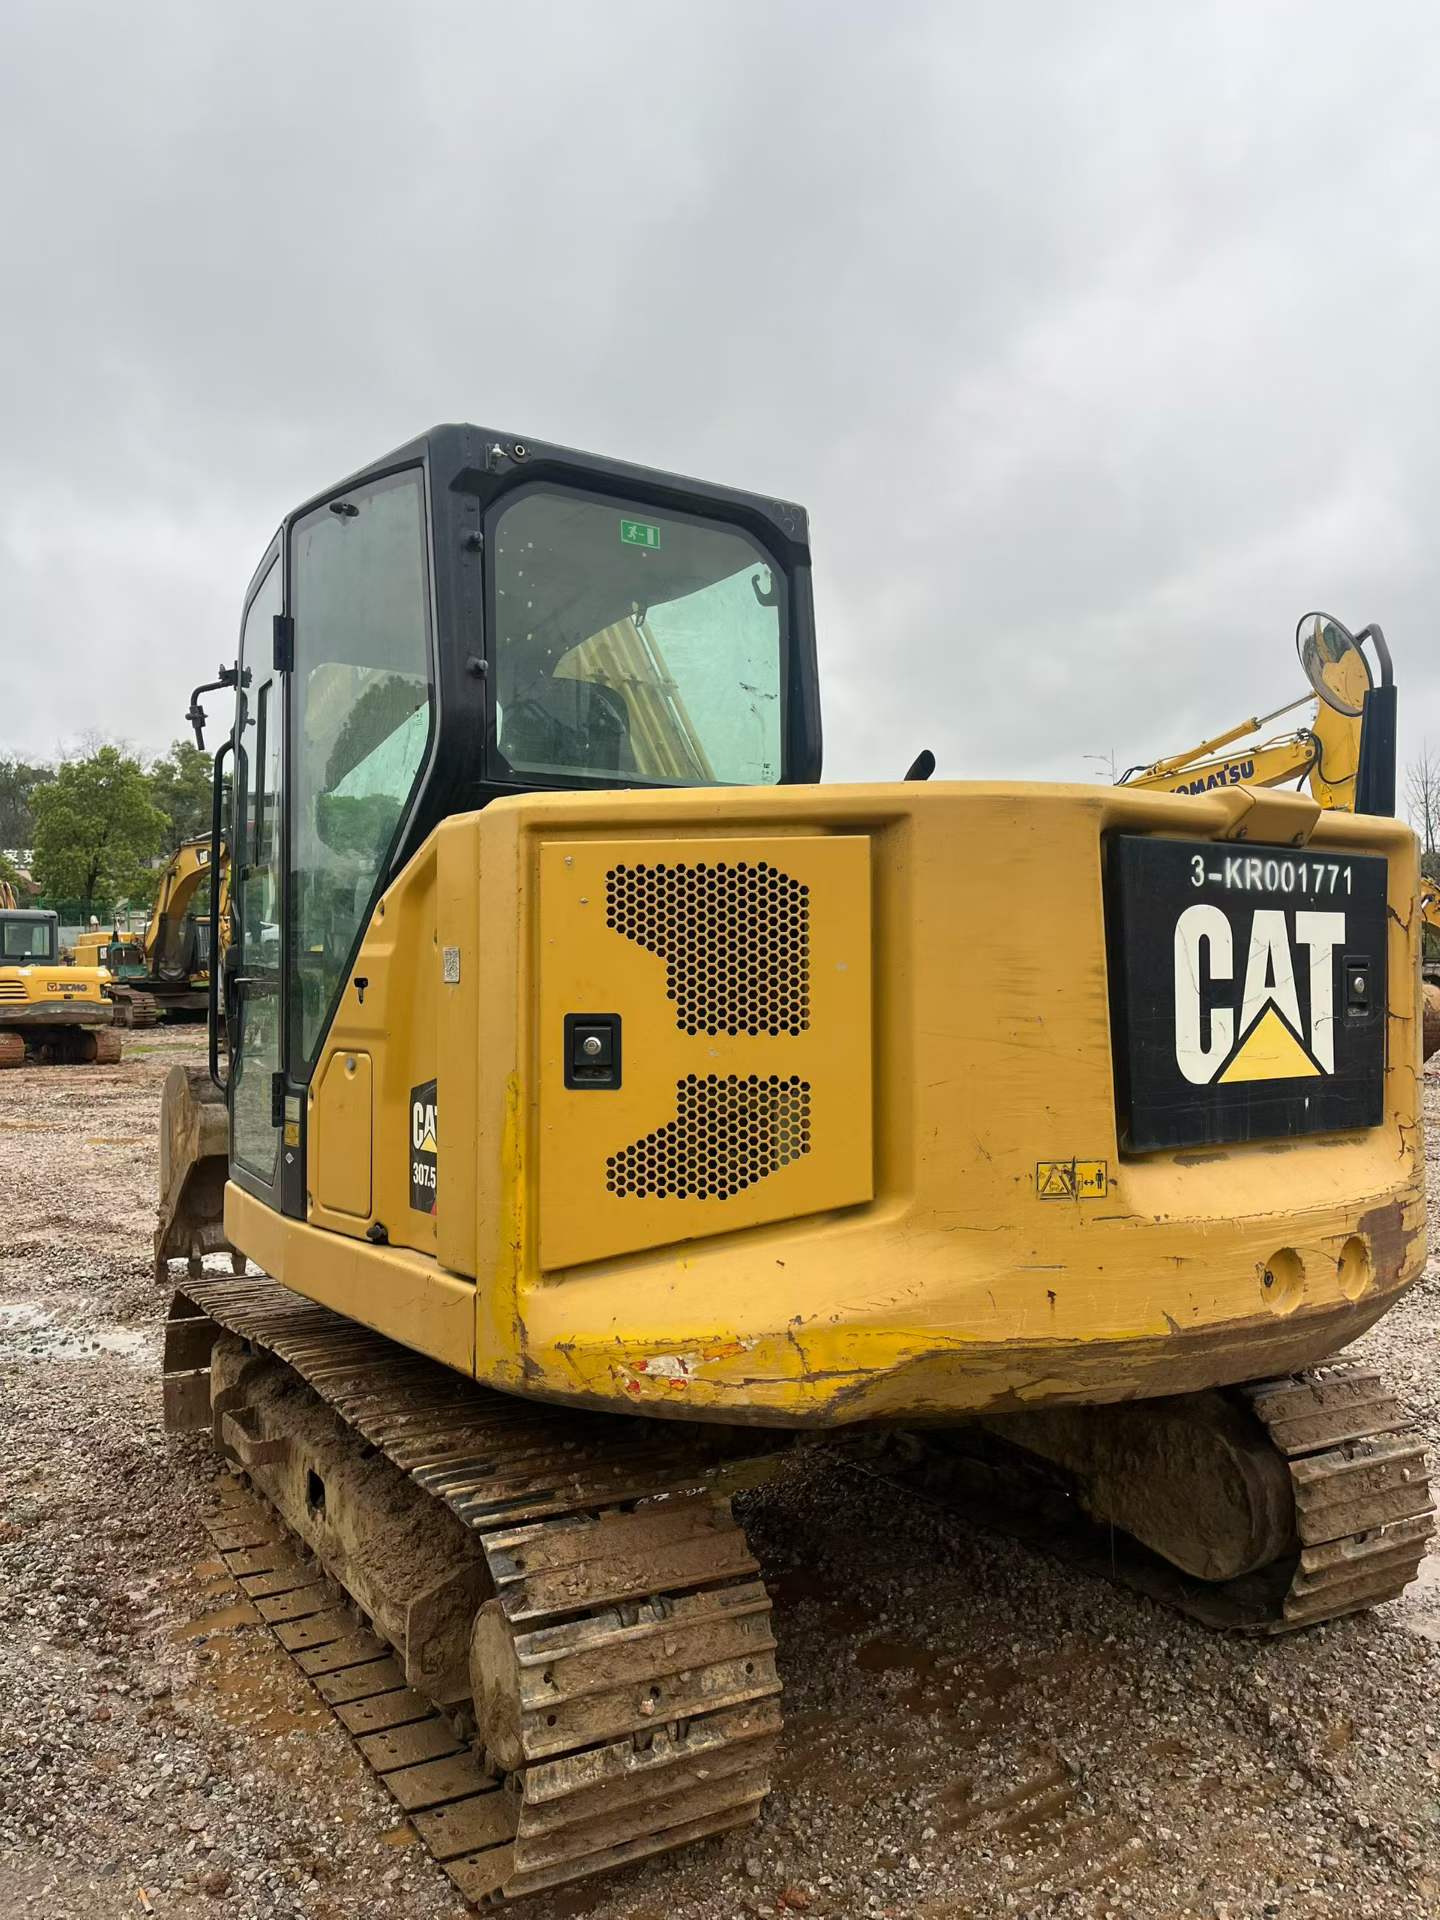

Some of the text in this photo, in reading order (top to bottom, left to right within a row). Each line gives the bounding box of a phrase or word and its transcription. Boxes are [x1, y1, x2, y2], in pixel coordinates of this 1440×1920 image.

[1170, 760, 1254, 795] OMATSU
[1191, 855, 1352, 895] 3-KR001771
[1174, 904, 1346, 1085] CAT
[413, 1162, 436, 1189] 307.5
